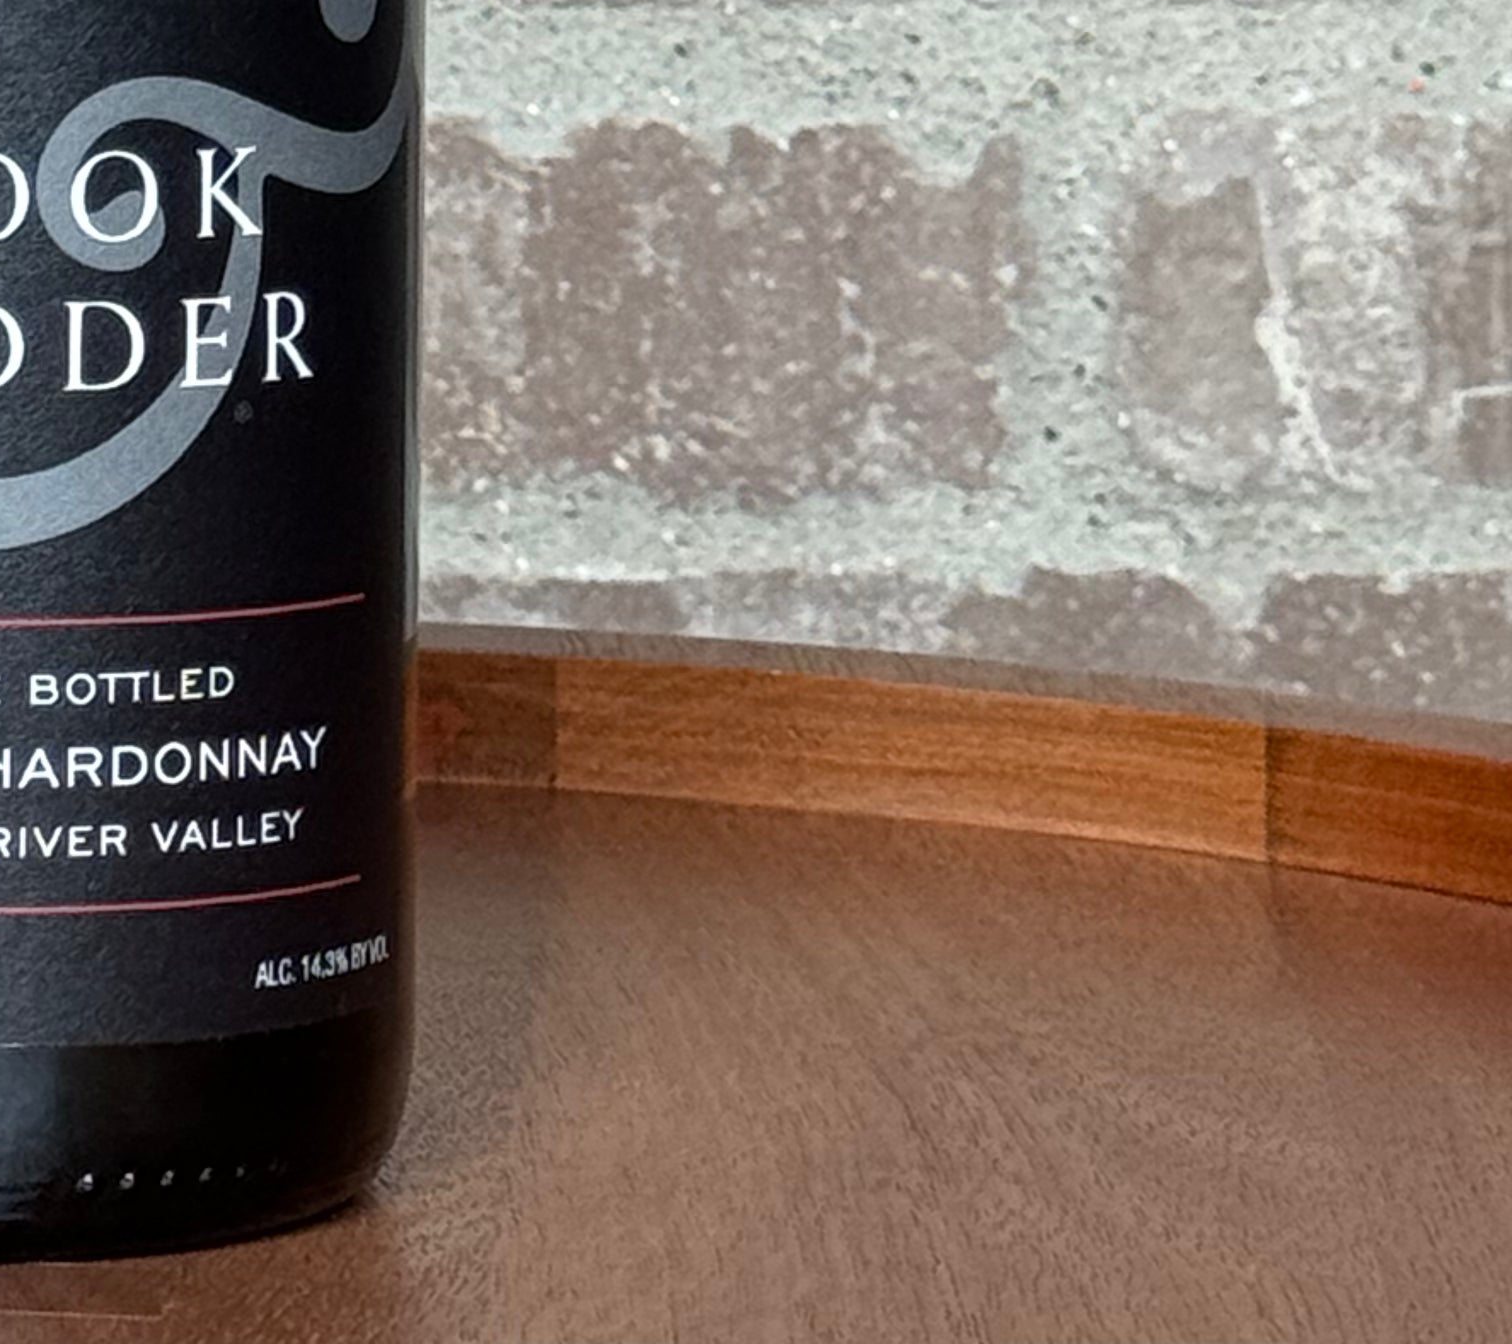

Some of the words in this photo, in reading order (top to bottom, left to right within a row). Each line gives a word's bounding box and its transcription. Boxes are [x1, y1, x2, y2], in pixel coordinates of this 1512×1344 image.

[29, 666, 235, 706] BOTTLED
[151, 808, 303, 853] VALLEY
[253, 957, 297, 990] ALC.
[350, 941, 369, 971] BY
